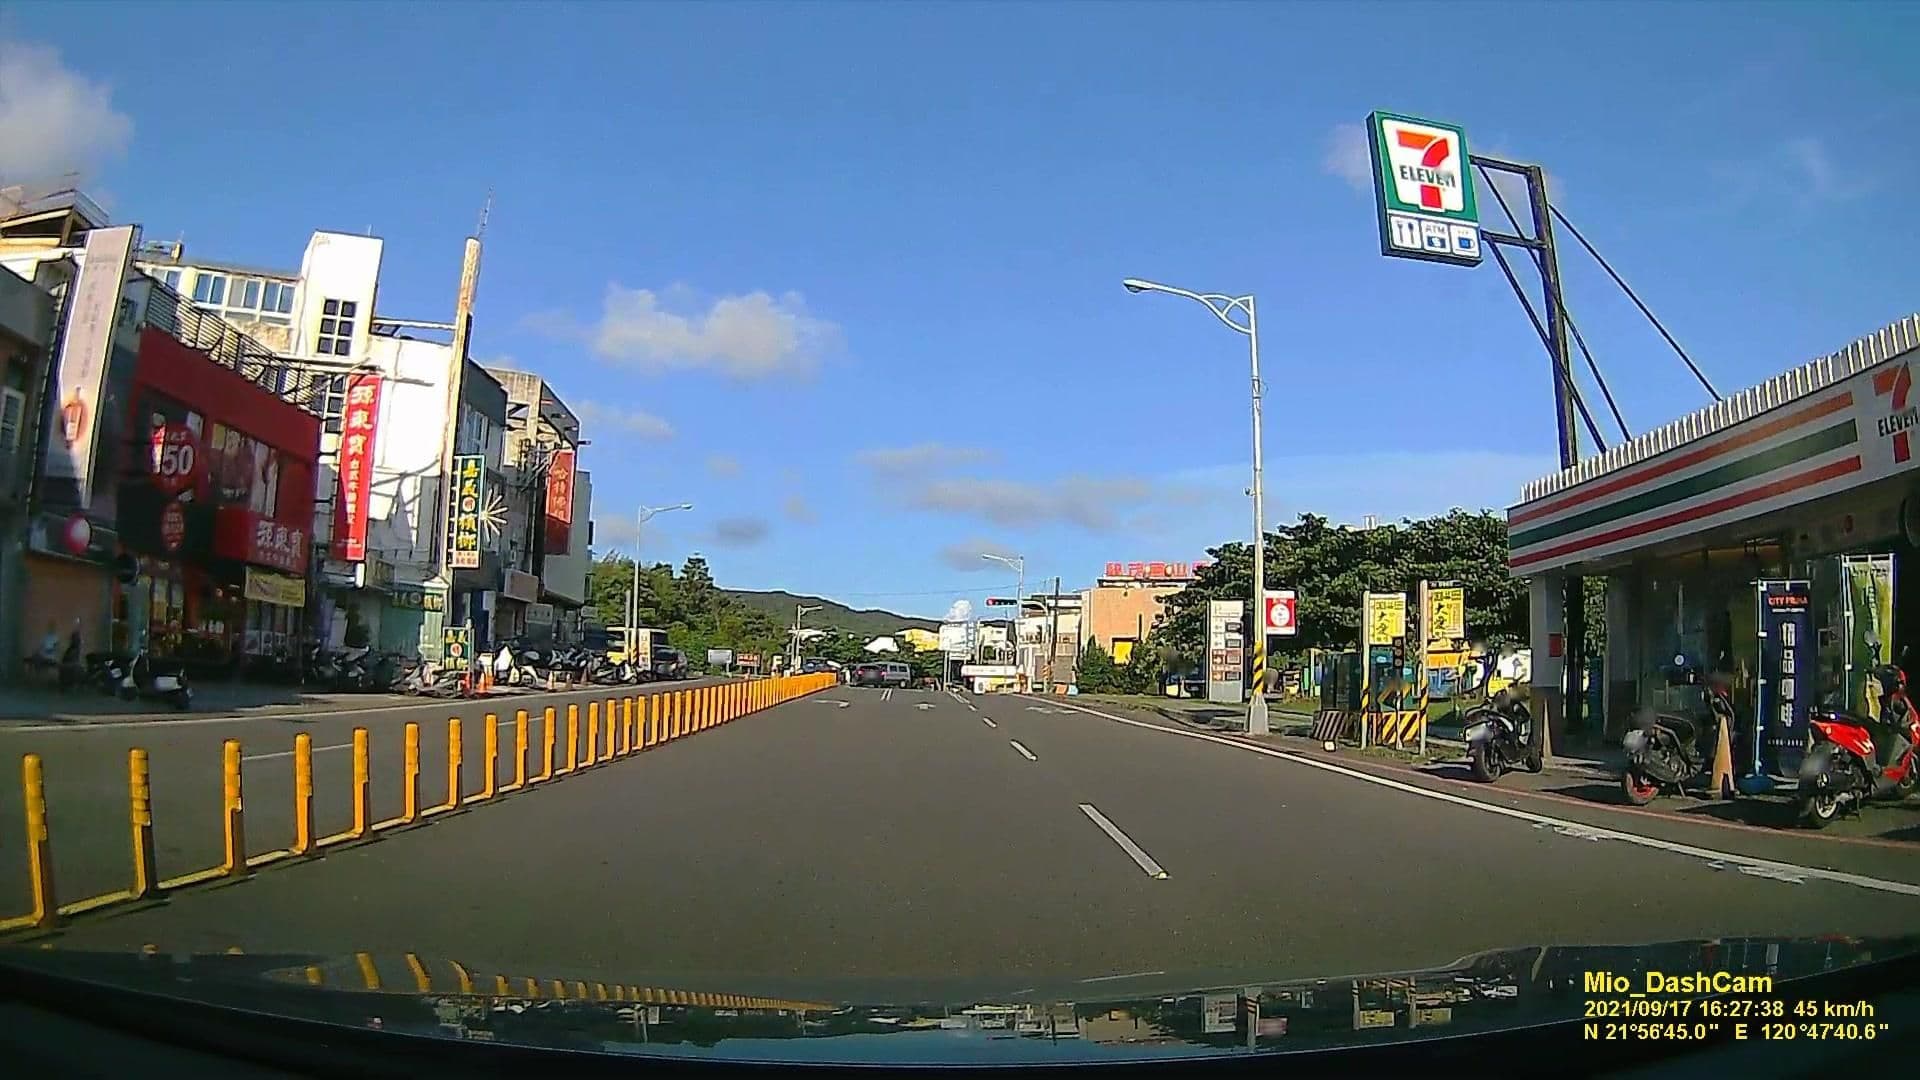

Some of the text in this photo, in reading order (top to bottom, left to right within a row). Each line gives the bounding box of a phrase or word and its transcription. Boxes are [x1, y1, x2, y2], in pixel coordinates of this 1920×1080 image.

[1397, 129, 1450, 209] 7
[1425, 225, 1446, 234] ATM
[1873, 361, 1912, 463] 7
